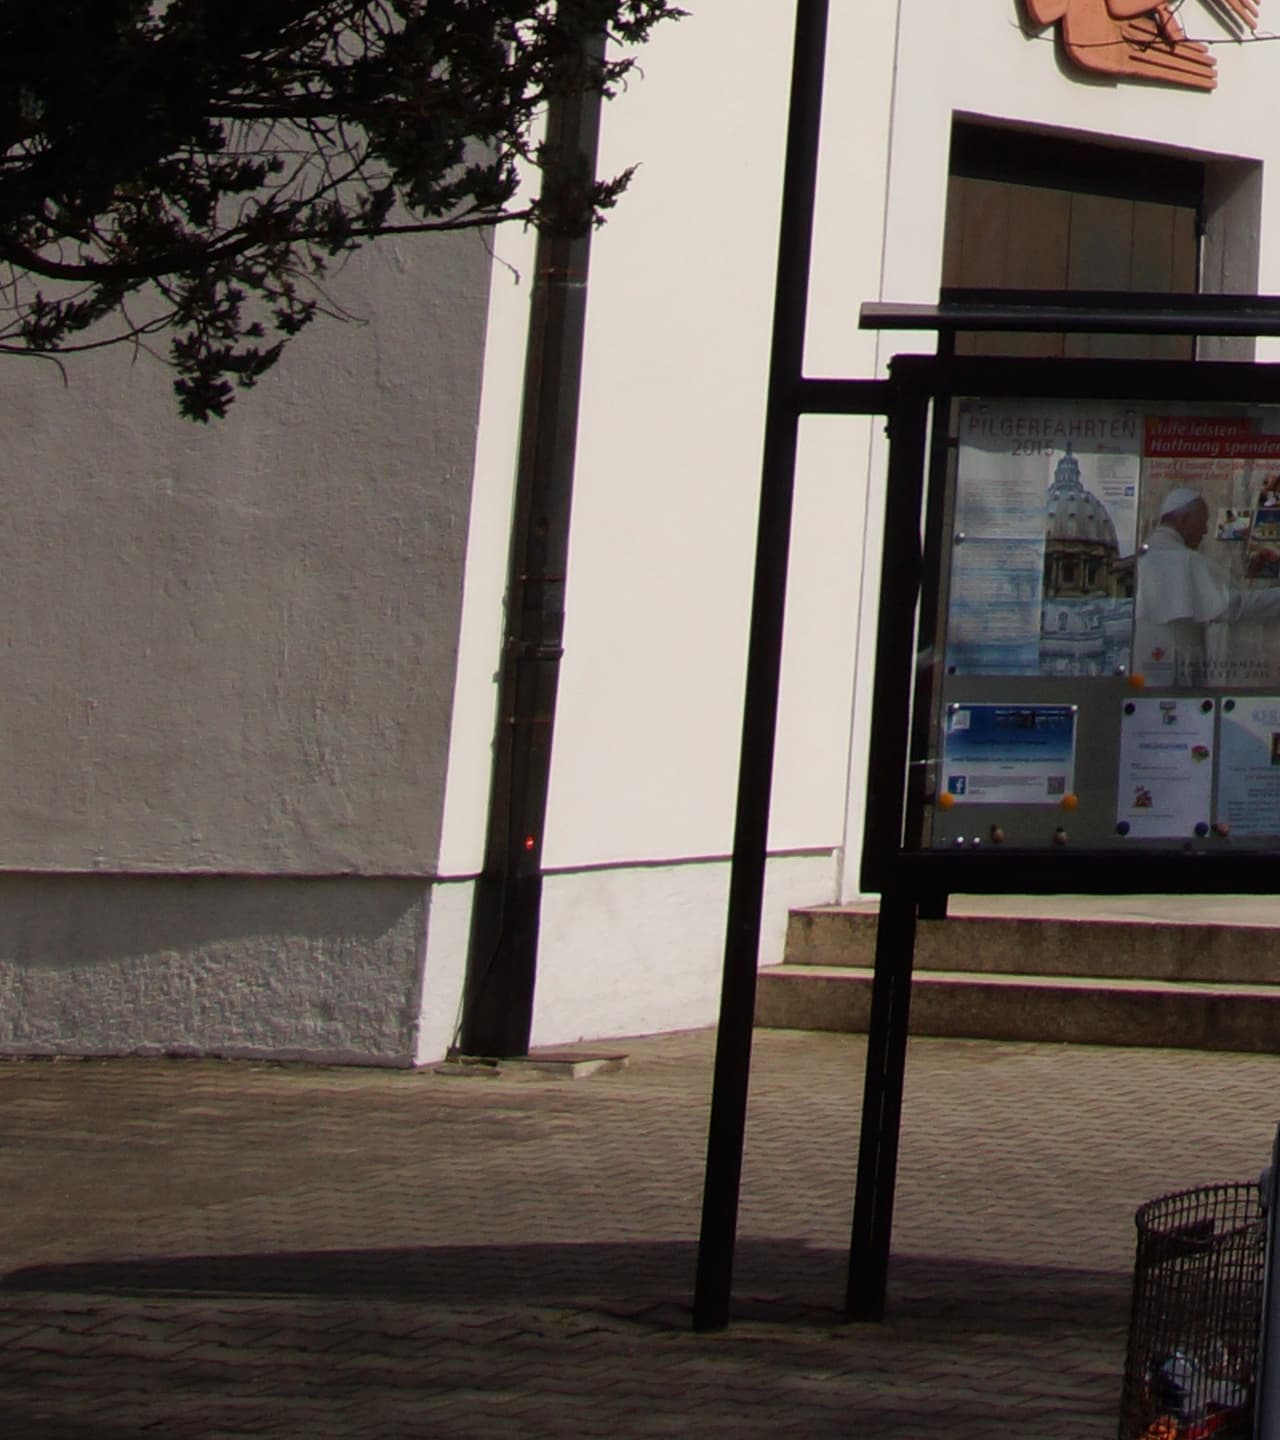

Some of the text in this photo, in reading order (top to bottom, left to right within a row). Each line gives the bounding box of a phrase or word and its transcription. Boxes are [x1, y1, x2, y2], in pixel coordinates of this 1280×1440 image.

[968, 416, 1136, 439] PILGERFAHRTEN
[1011, 439, 1055, 456] 2015
[1151, 437, 1220, 456] Hoffnung
